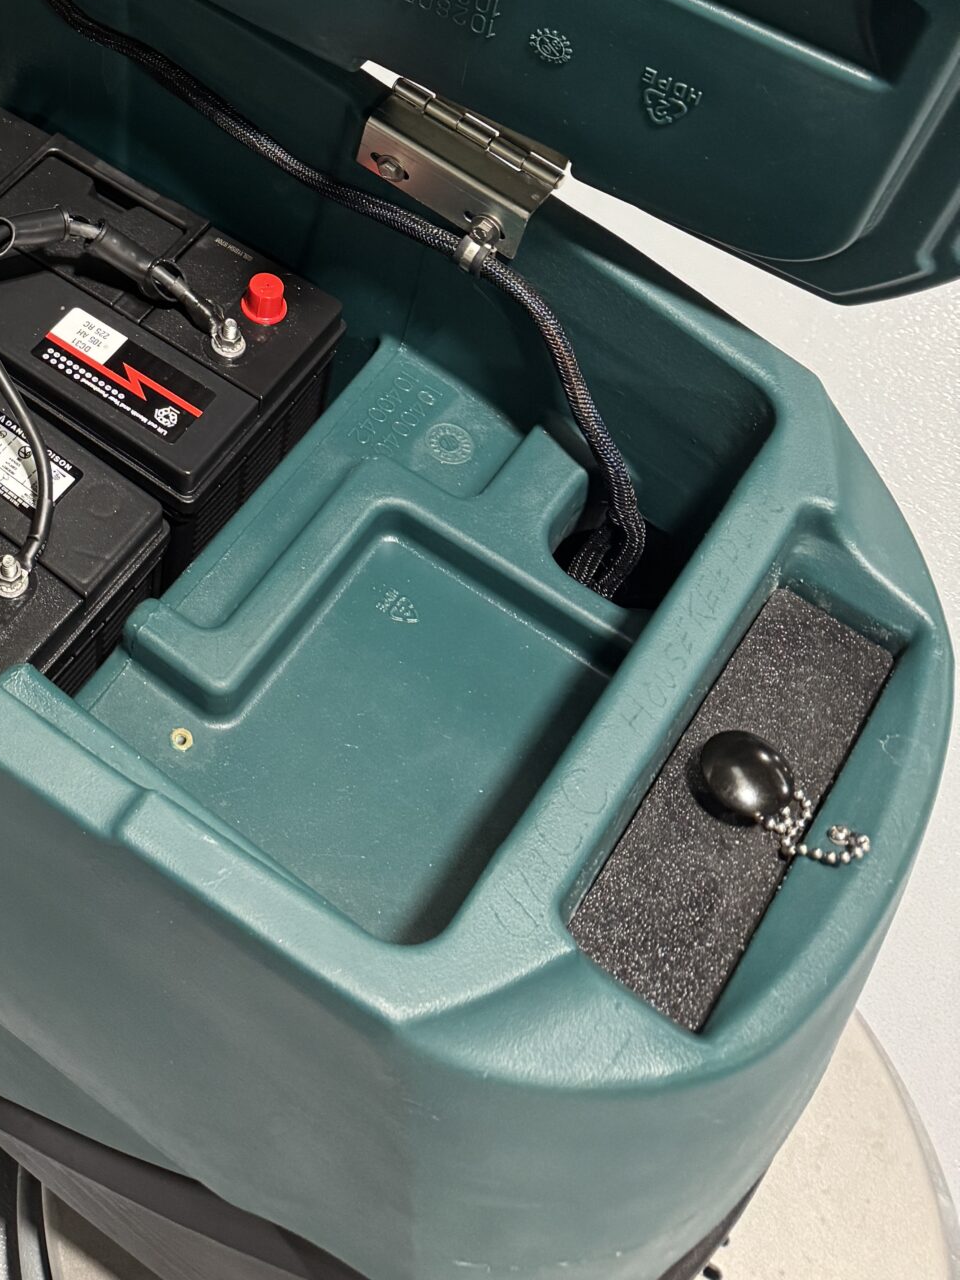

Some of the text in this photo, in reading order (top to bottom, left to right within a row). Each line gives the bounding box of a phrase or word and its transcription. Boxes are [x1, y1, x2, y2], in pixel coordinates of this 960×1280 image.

[642, 66, 703, 107] HDPE
[76, 328, 103, 348] 105 AH
[82, 320, 111, 340] 225 RC
[71, 338, 92, 353] DC31
[347, 370, 419, 444] 1040042
